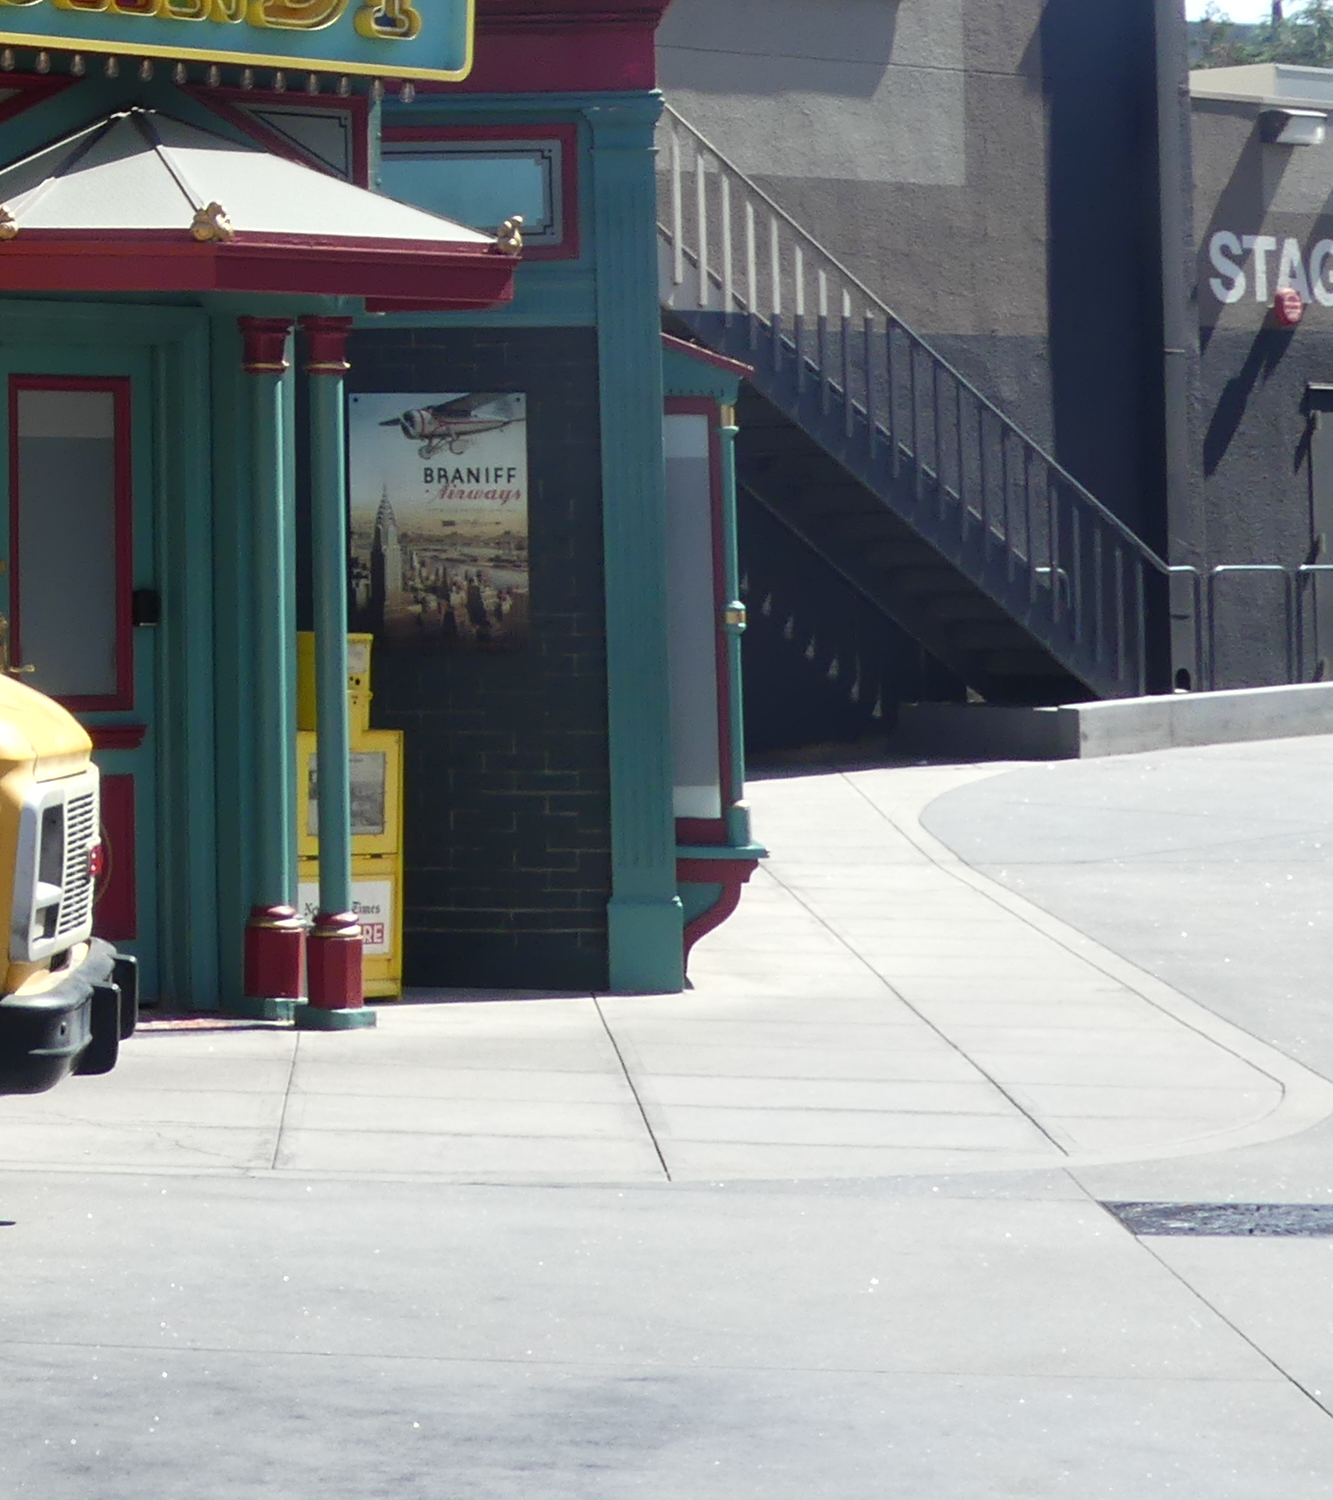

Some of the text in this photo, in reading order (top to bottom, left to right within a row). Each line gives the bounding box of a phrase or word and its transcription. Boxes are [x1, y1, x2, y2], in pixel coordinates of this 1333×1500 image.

[1209, 230, 1333, 307] STAG
[423, 466, 517, 484] BRANIFF
[434, 483, 522, 506] Airways
[351, 901, 381, 915] Times
